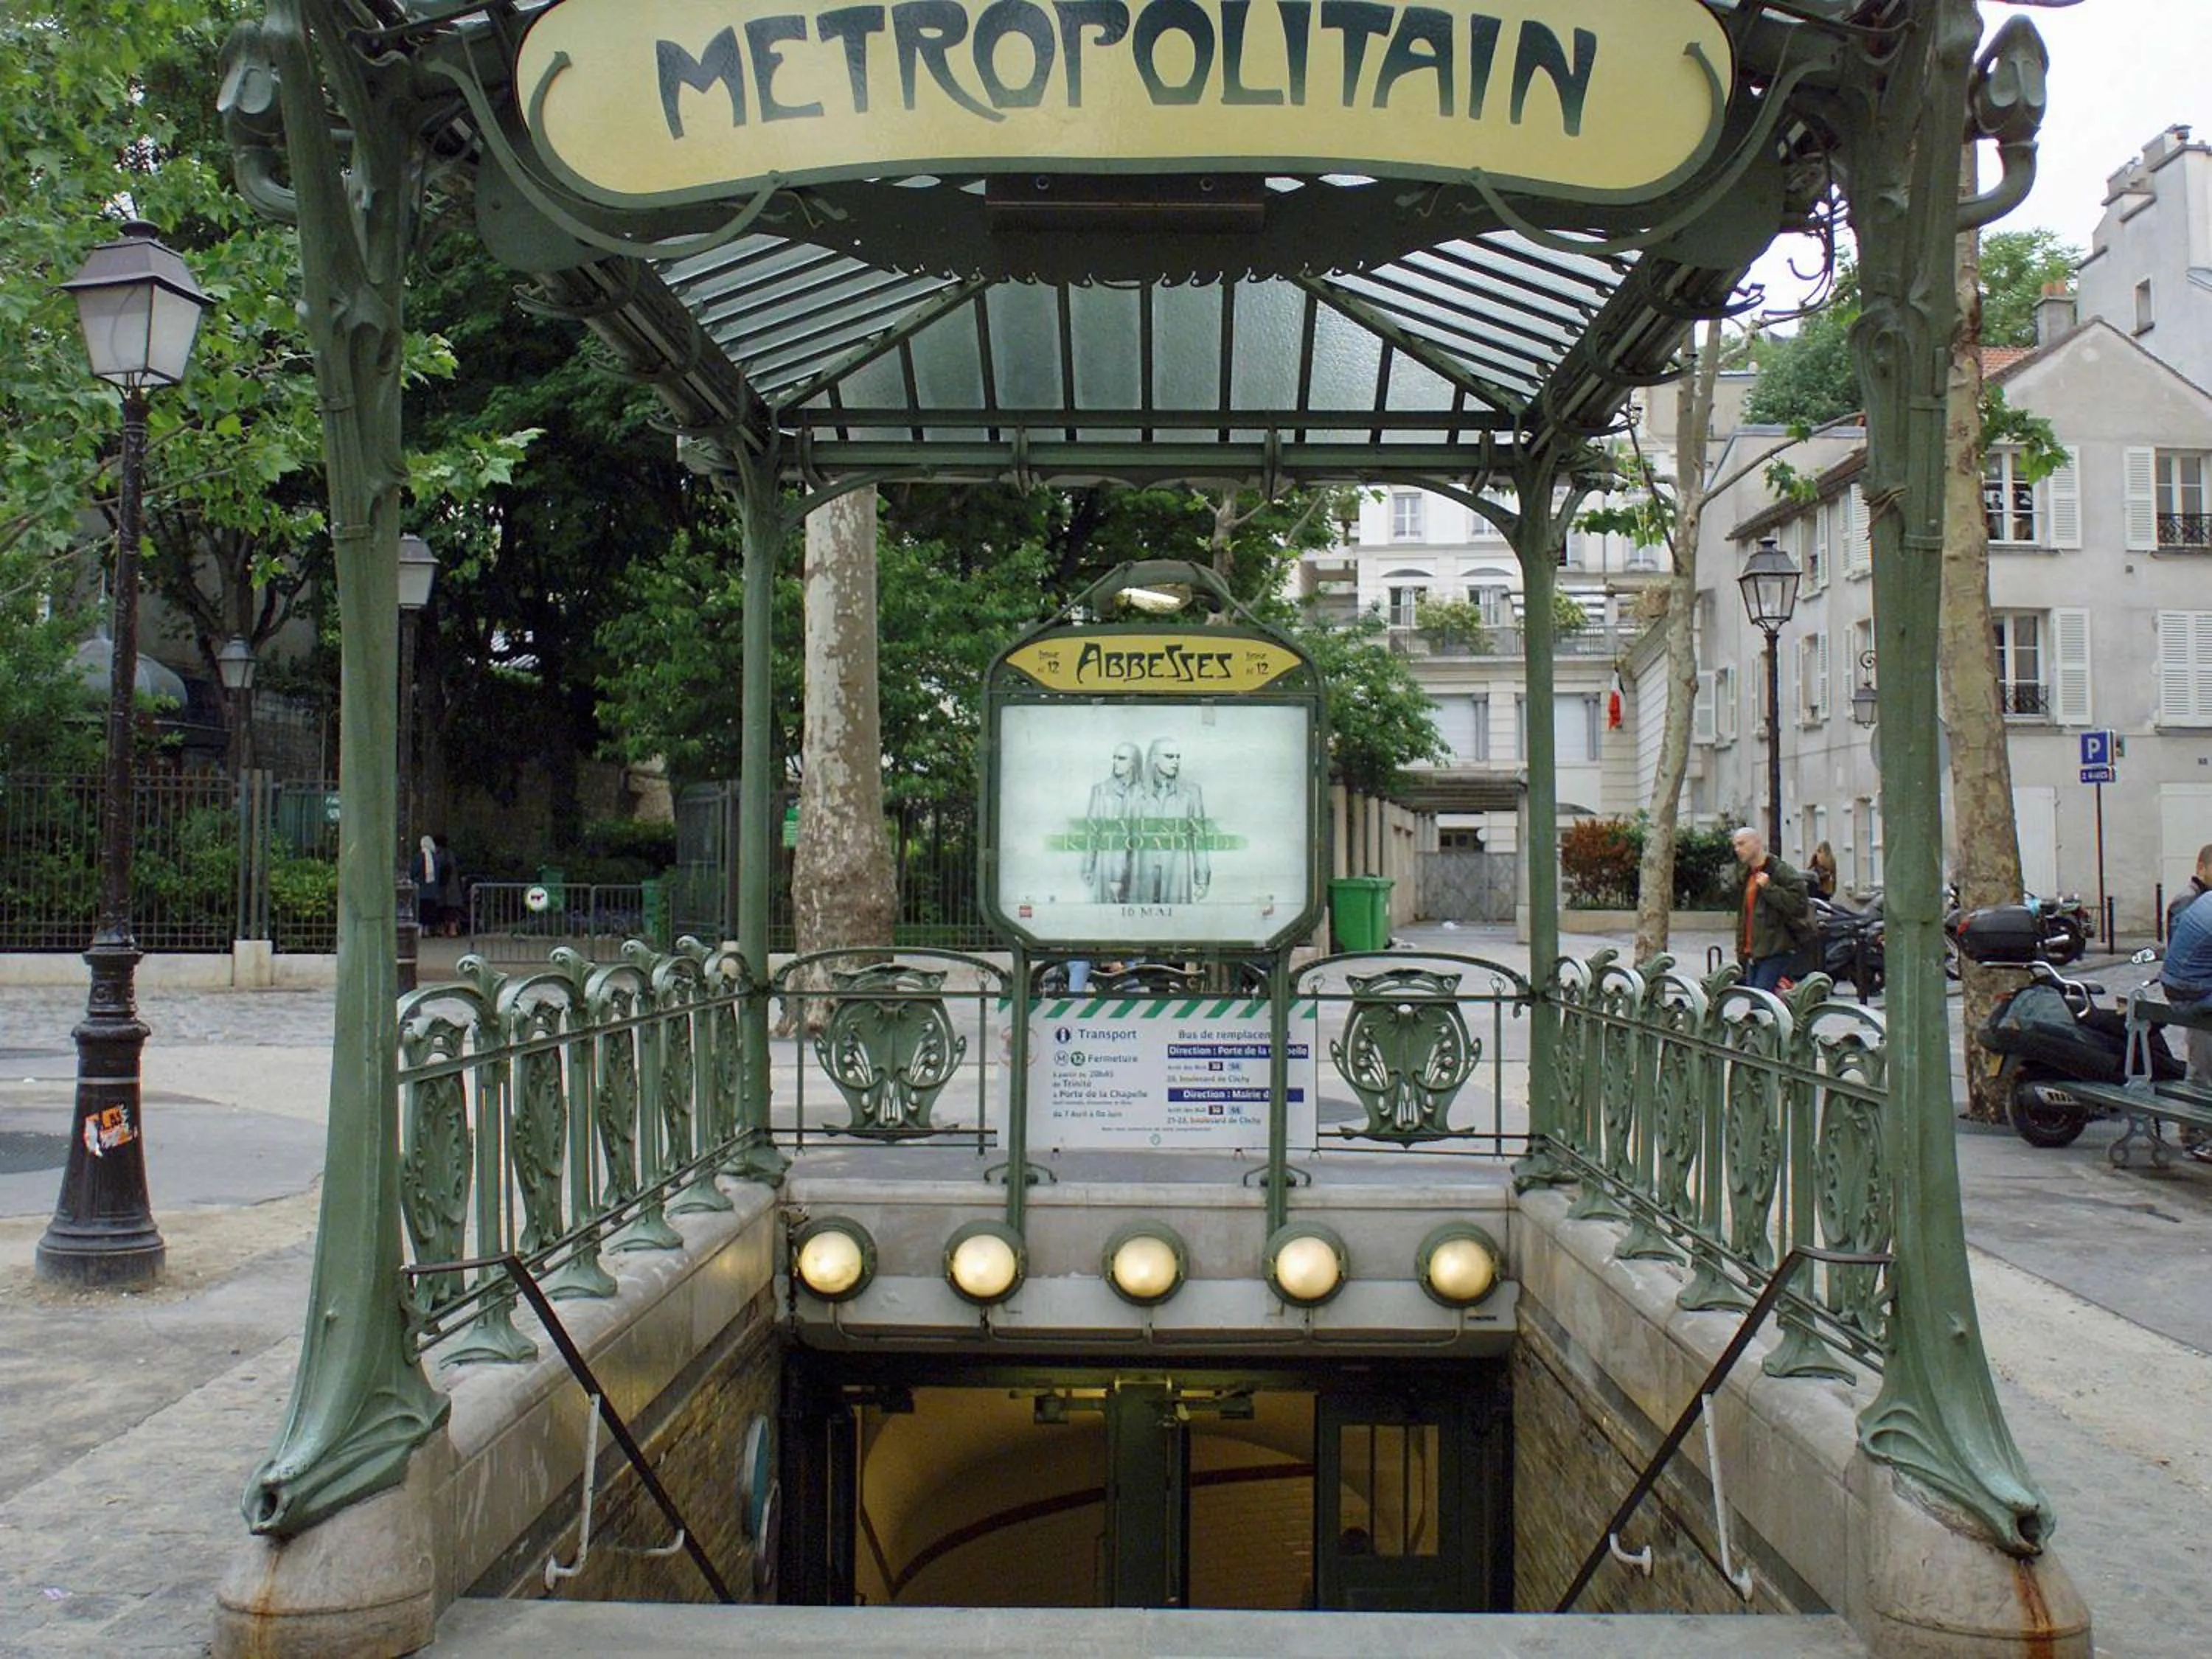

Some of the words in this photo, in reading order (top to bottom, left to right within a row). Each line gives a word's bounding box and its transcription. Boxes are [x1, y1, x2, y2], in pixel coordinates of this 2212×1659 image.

[656, 0, 1596, 140] METROPOLITAIN
[1048, 661, 1060, 672] 12
[1077, 642, 1232, 684] ABBESSES
[1257, 662, 1268, 675] 12
[2088, 738, 2101, 759] P
[1078, 1029, 1137, 1042] Transport
[1200, 1030, 1212, 1039] de
[1169, 1046, 1211, 1055] Direction
[1218, 1047, 1242, 1055] Porte
[1245, 1046, 1256, 1055] de
[1258, 1046, 1267, 1055] la
[1088, 1054, 1138, 1063] Fermeture
[1060, 1090, 1082, 1098] Porte
[1085, 1089, 1097, 1098] de
[1099, 1089, 1107, 1098] la
[1110, 1089, 1147, 1099] Chapelle
[1183, 1090, 1225, 1099] Direction
[1232, 1090, 1261, 1099] Mairie
